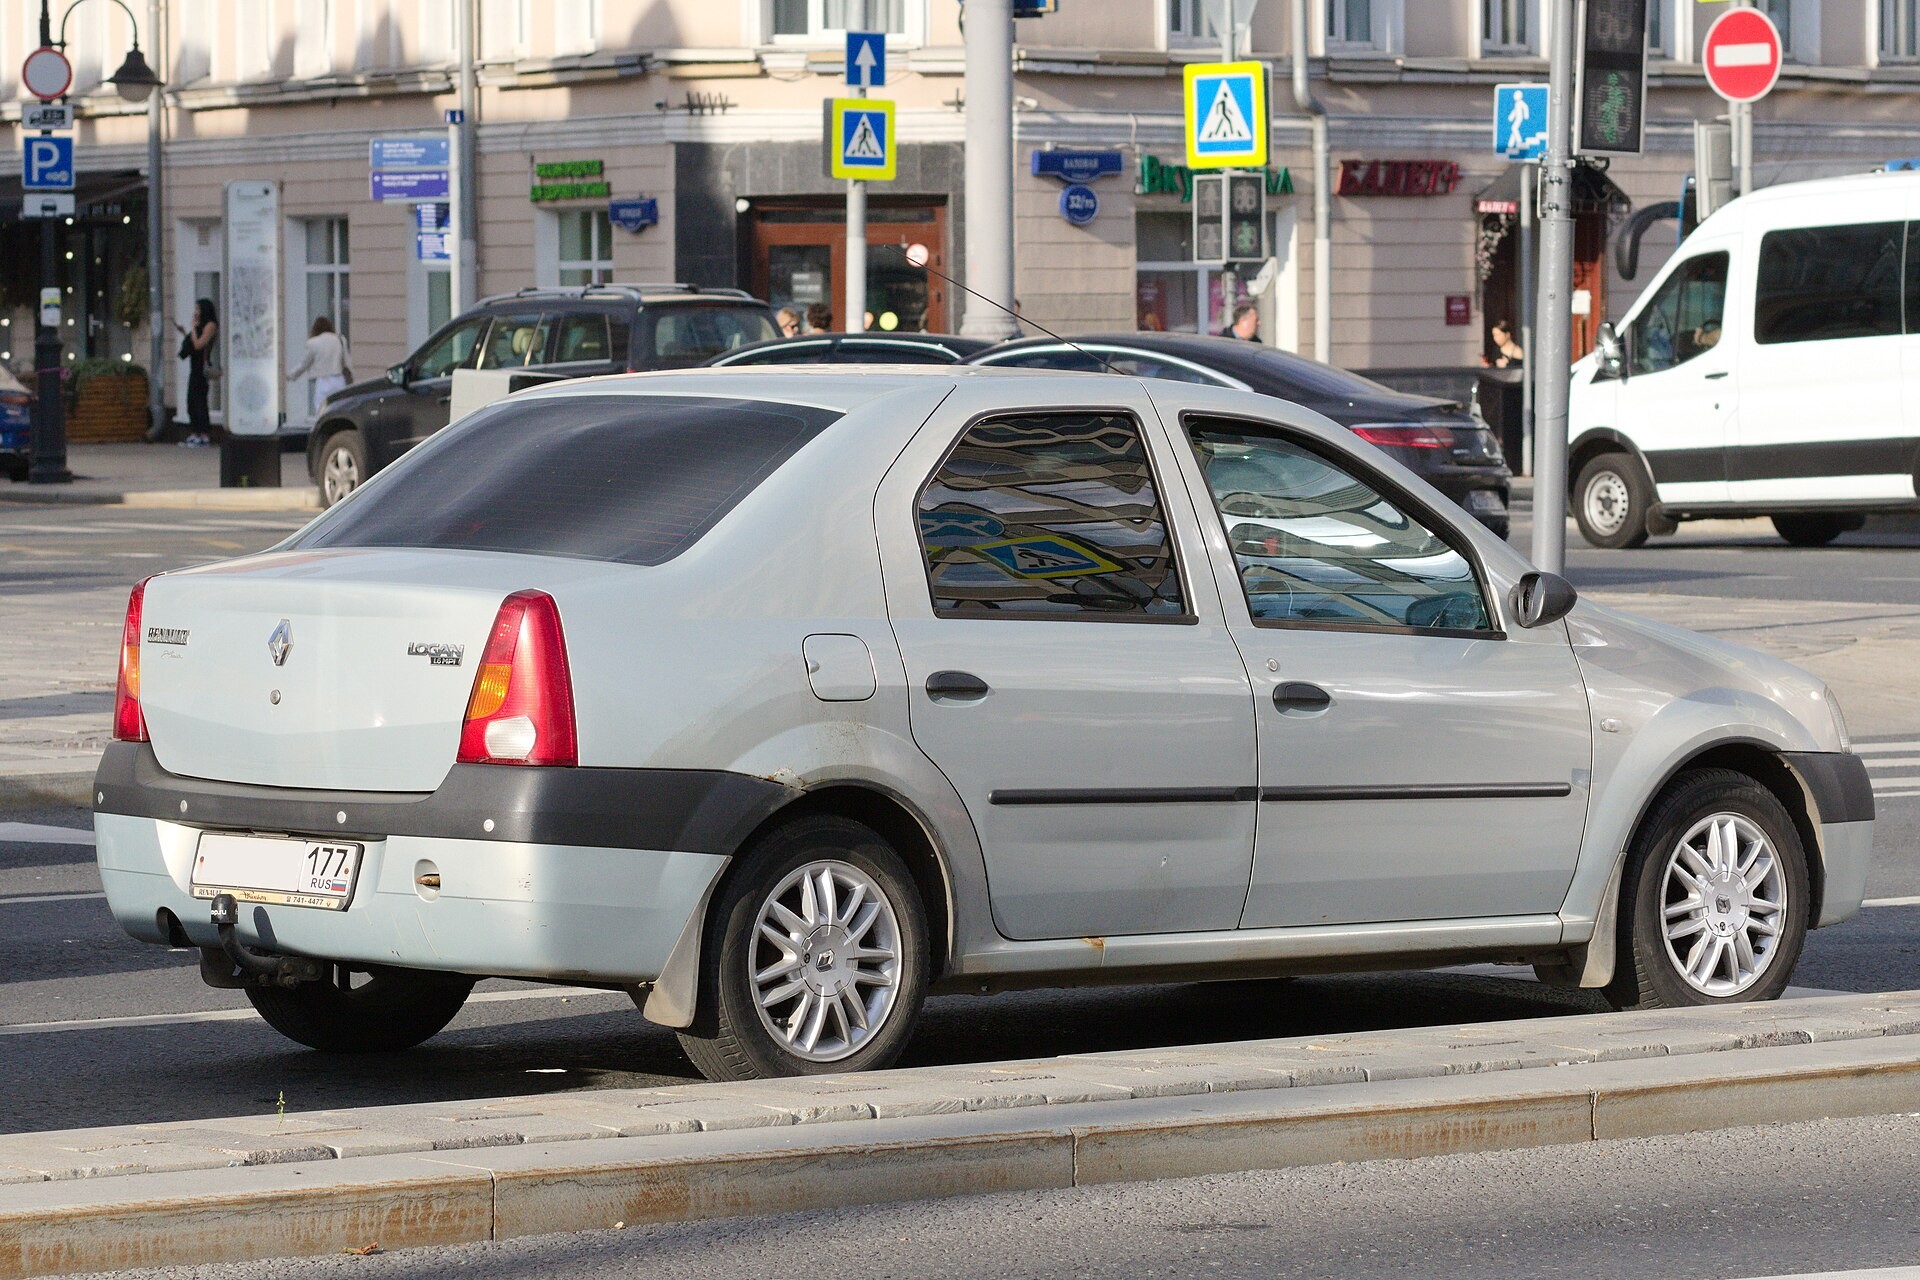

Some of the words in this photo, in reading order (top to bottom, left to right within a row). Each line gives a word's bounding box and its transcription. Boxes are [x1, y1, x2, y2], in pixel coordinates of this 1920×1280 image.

[31, 140, 60, 182] P
[408, 641, 465, 657] LOGAN
[307, 846, 348, 878] 177
[310, 877, 332, 890] RUS
